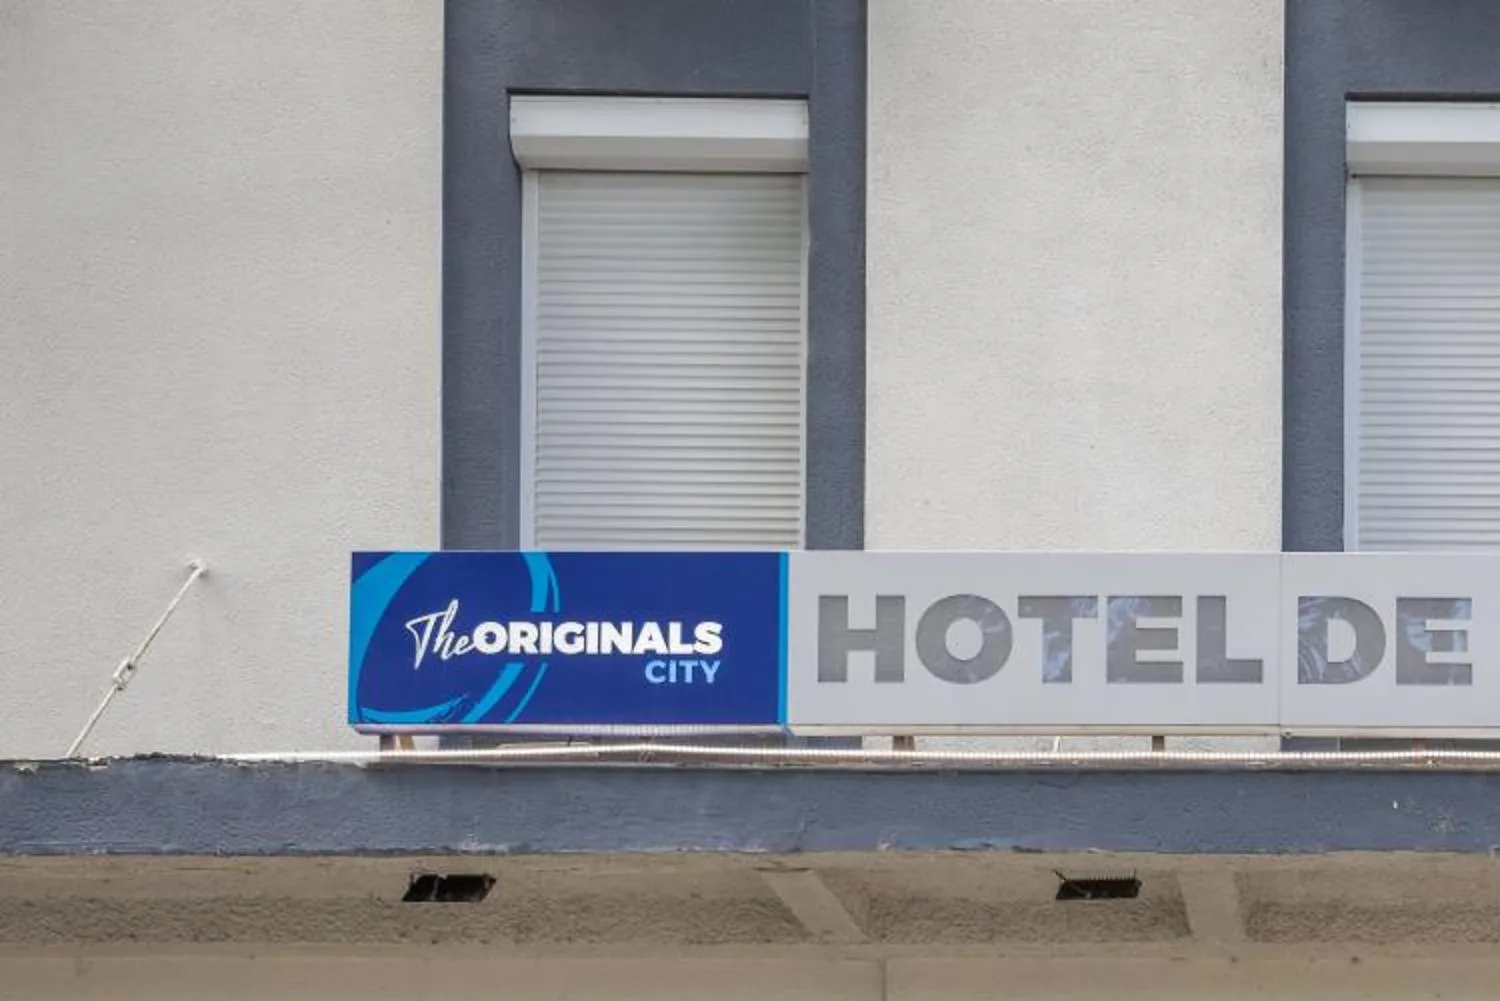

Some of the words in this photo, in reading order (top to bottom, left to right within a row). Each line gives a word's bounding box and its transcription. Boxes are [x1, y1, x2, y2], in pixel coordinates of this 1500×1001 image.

[472, 621, 724, 655] ORIGINALS
[817, 594, 1264, 685] HOTEL
[1297, 595, 1473, 686] DE
[644, 659, 721, 684] CITY
